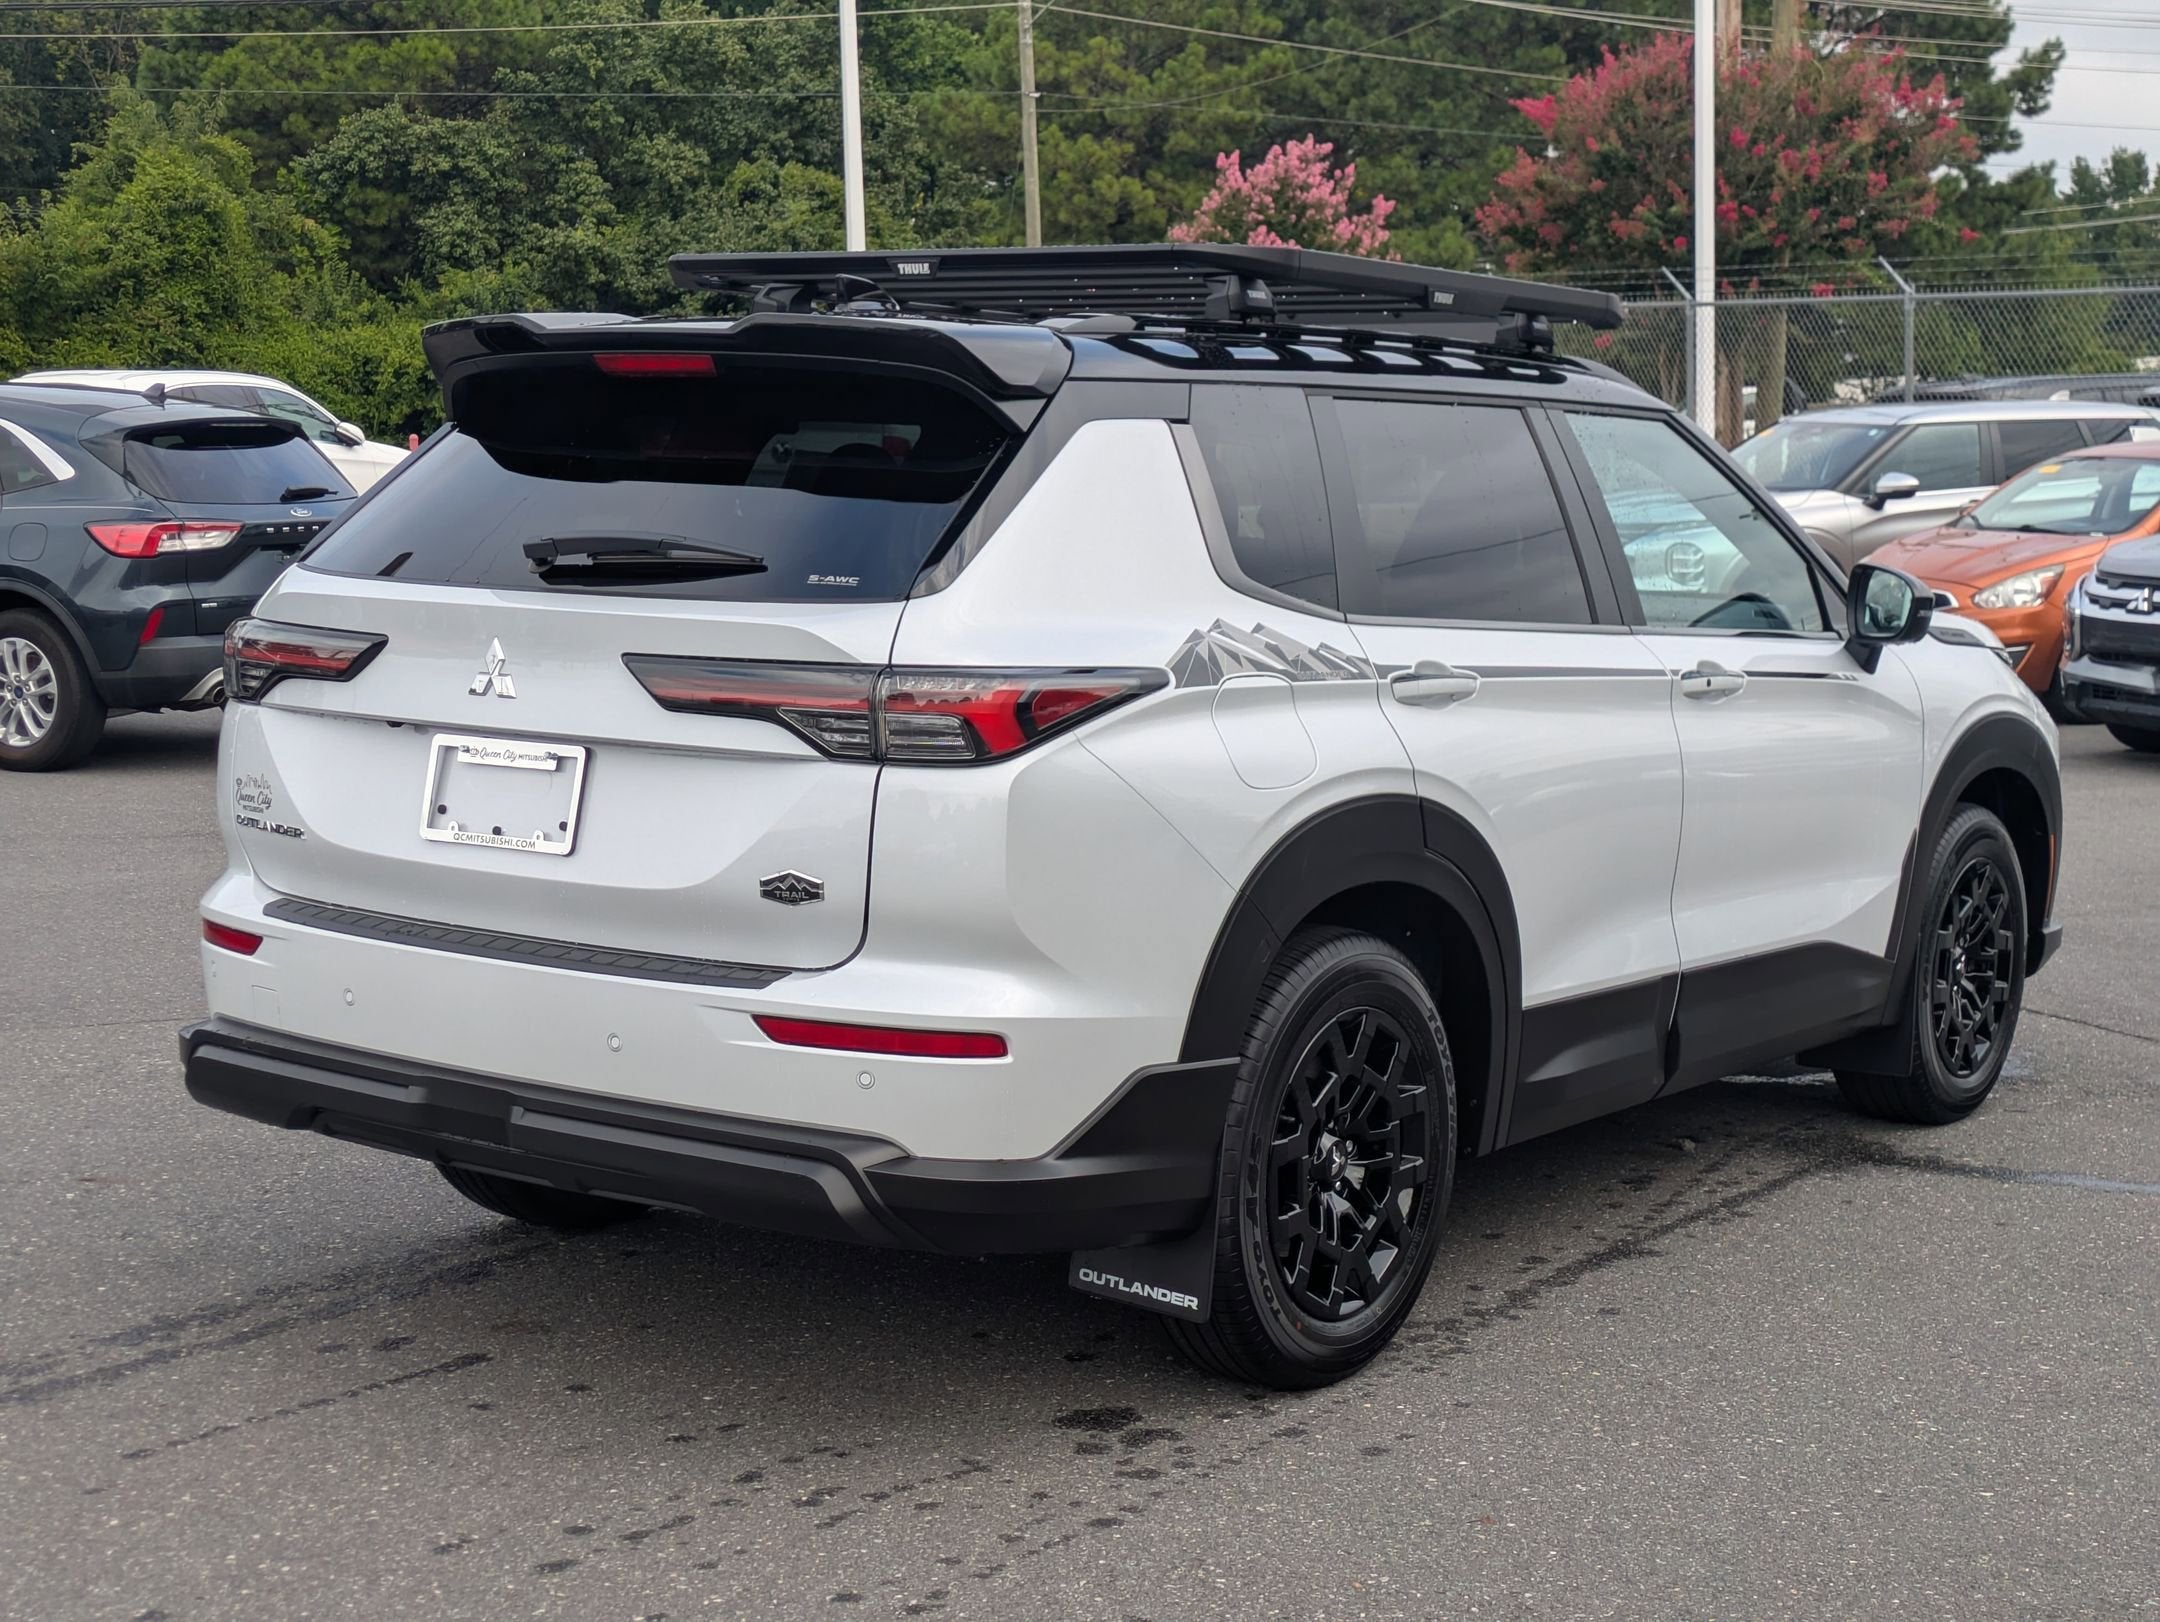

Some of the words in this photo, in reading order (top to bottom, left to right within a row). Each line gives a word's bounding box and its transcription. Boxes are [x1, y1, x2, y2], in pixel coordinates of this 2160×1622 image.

[897, 262, 931, 275] THULE
[807, 574, 861, 584] S-AWC
[479, 746, 502, 761] Queen
[502, 748, 519, 763] City
[236, 787, 256, 806] Queen
[257, 791, 273, 810] City
[236, 813, 307, 841] OUTLANDER
[453, 832, 536, 849] QCMITSUBISHI.COM
[774, 890, 810, 900] TRAIL
[1078, 1268, 1199, 1311] OUTLANDER
